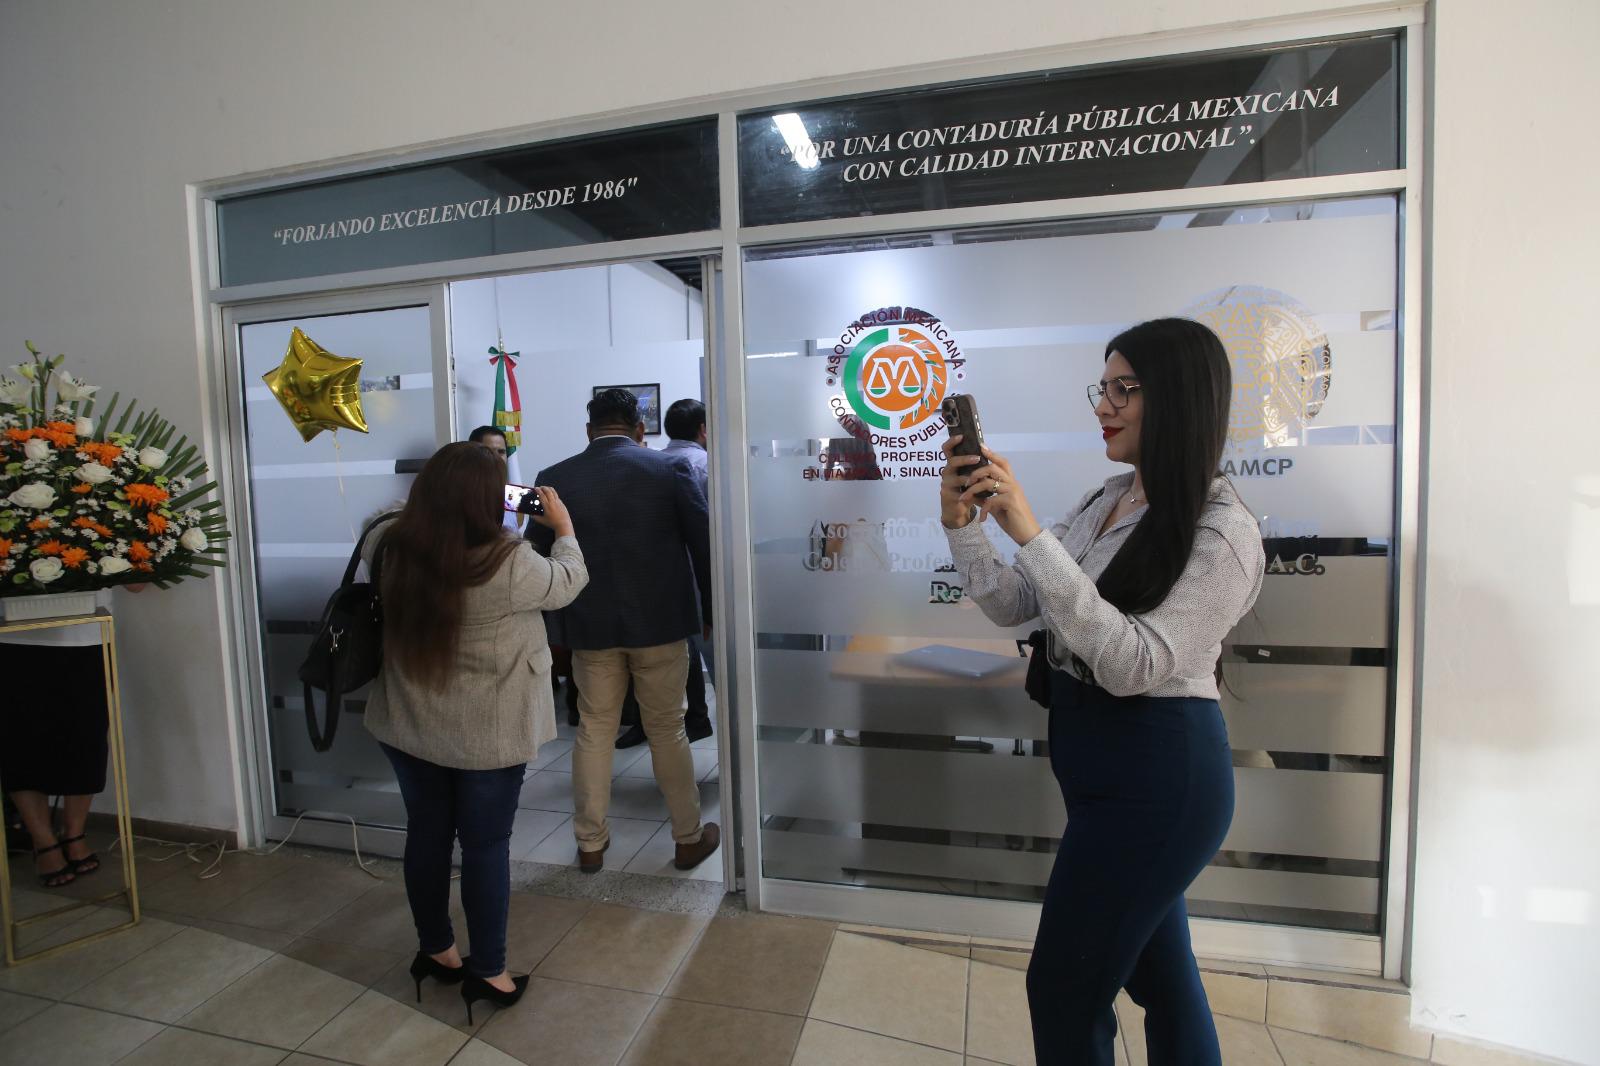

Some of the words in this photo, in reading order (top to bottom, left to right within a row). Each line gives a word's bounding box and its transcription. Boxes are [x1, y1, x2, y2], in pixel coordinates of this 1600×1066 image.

[843, 133, 891, 156] UNA
[897, 110, 1059, 150] CONTADURÍA
[1066, 105, 1180, 134] PÚBLICA
[1189, 86, 1340, 122] MEXICANA
[843, 160, 894, 182] CON
[899, 149, 1009, 177] CALIDAD
[1013, 125, 1256, 167] INTERNACIONAL”.
[274, 216, 376, 246] “FORJANDO
[379, 197, 502, 232] EXCELENCIA
[506, 186, 577, 213] DESDE
[580, 176, 638, 203] 1986"
[827, 308, 900, 375] ASOCIACIÓN
[904, 309, 964, 370] MEXICANA
[802, 468, 820, 480] EN
[899, 467, 945, 479] SINALO
[881, 451, 948, 463] PROFESIO
[888, 551, 957, 573] Profes
